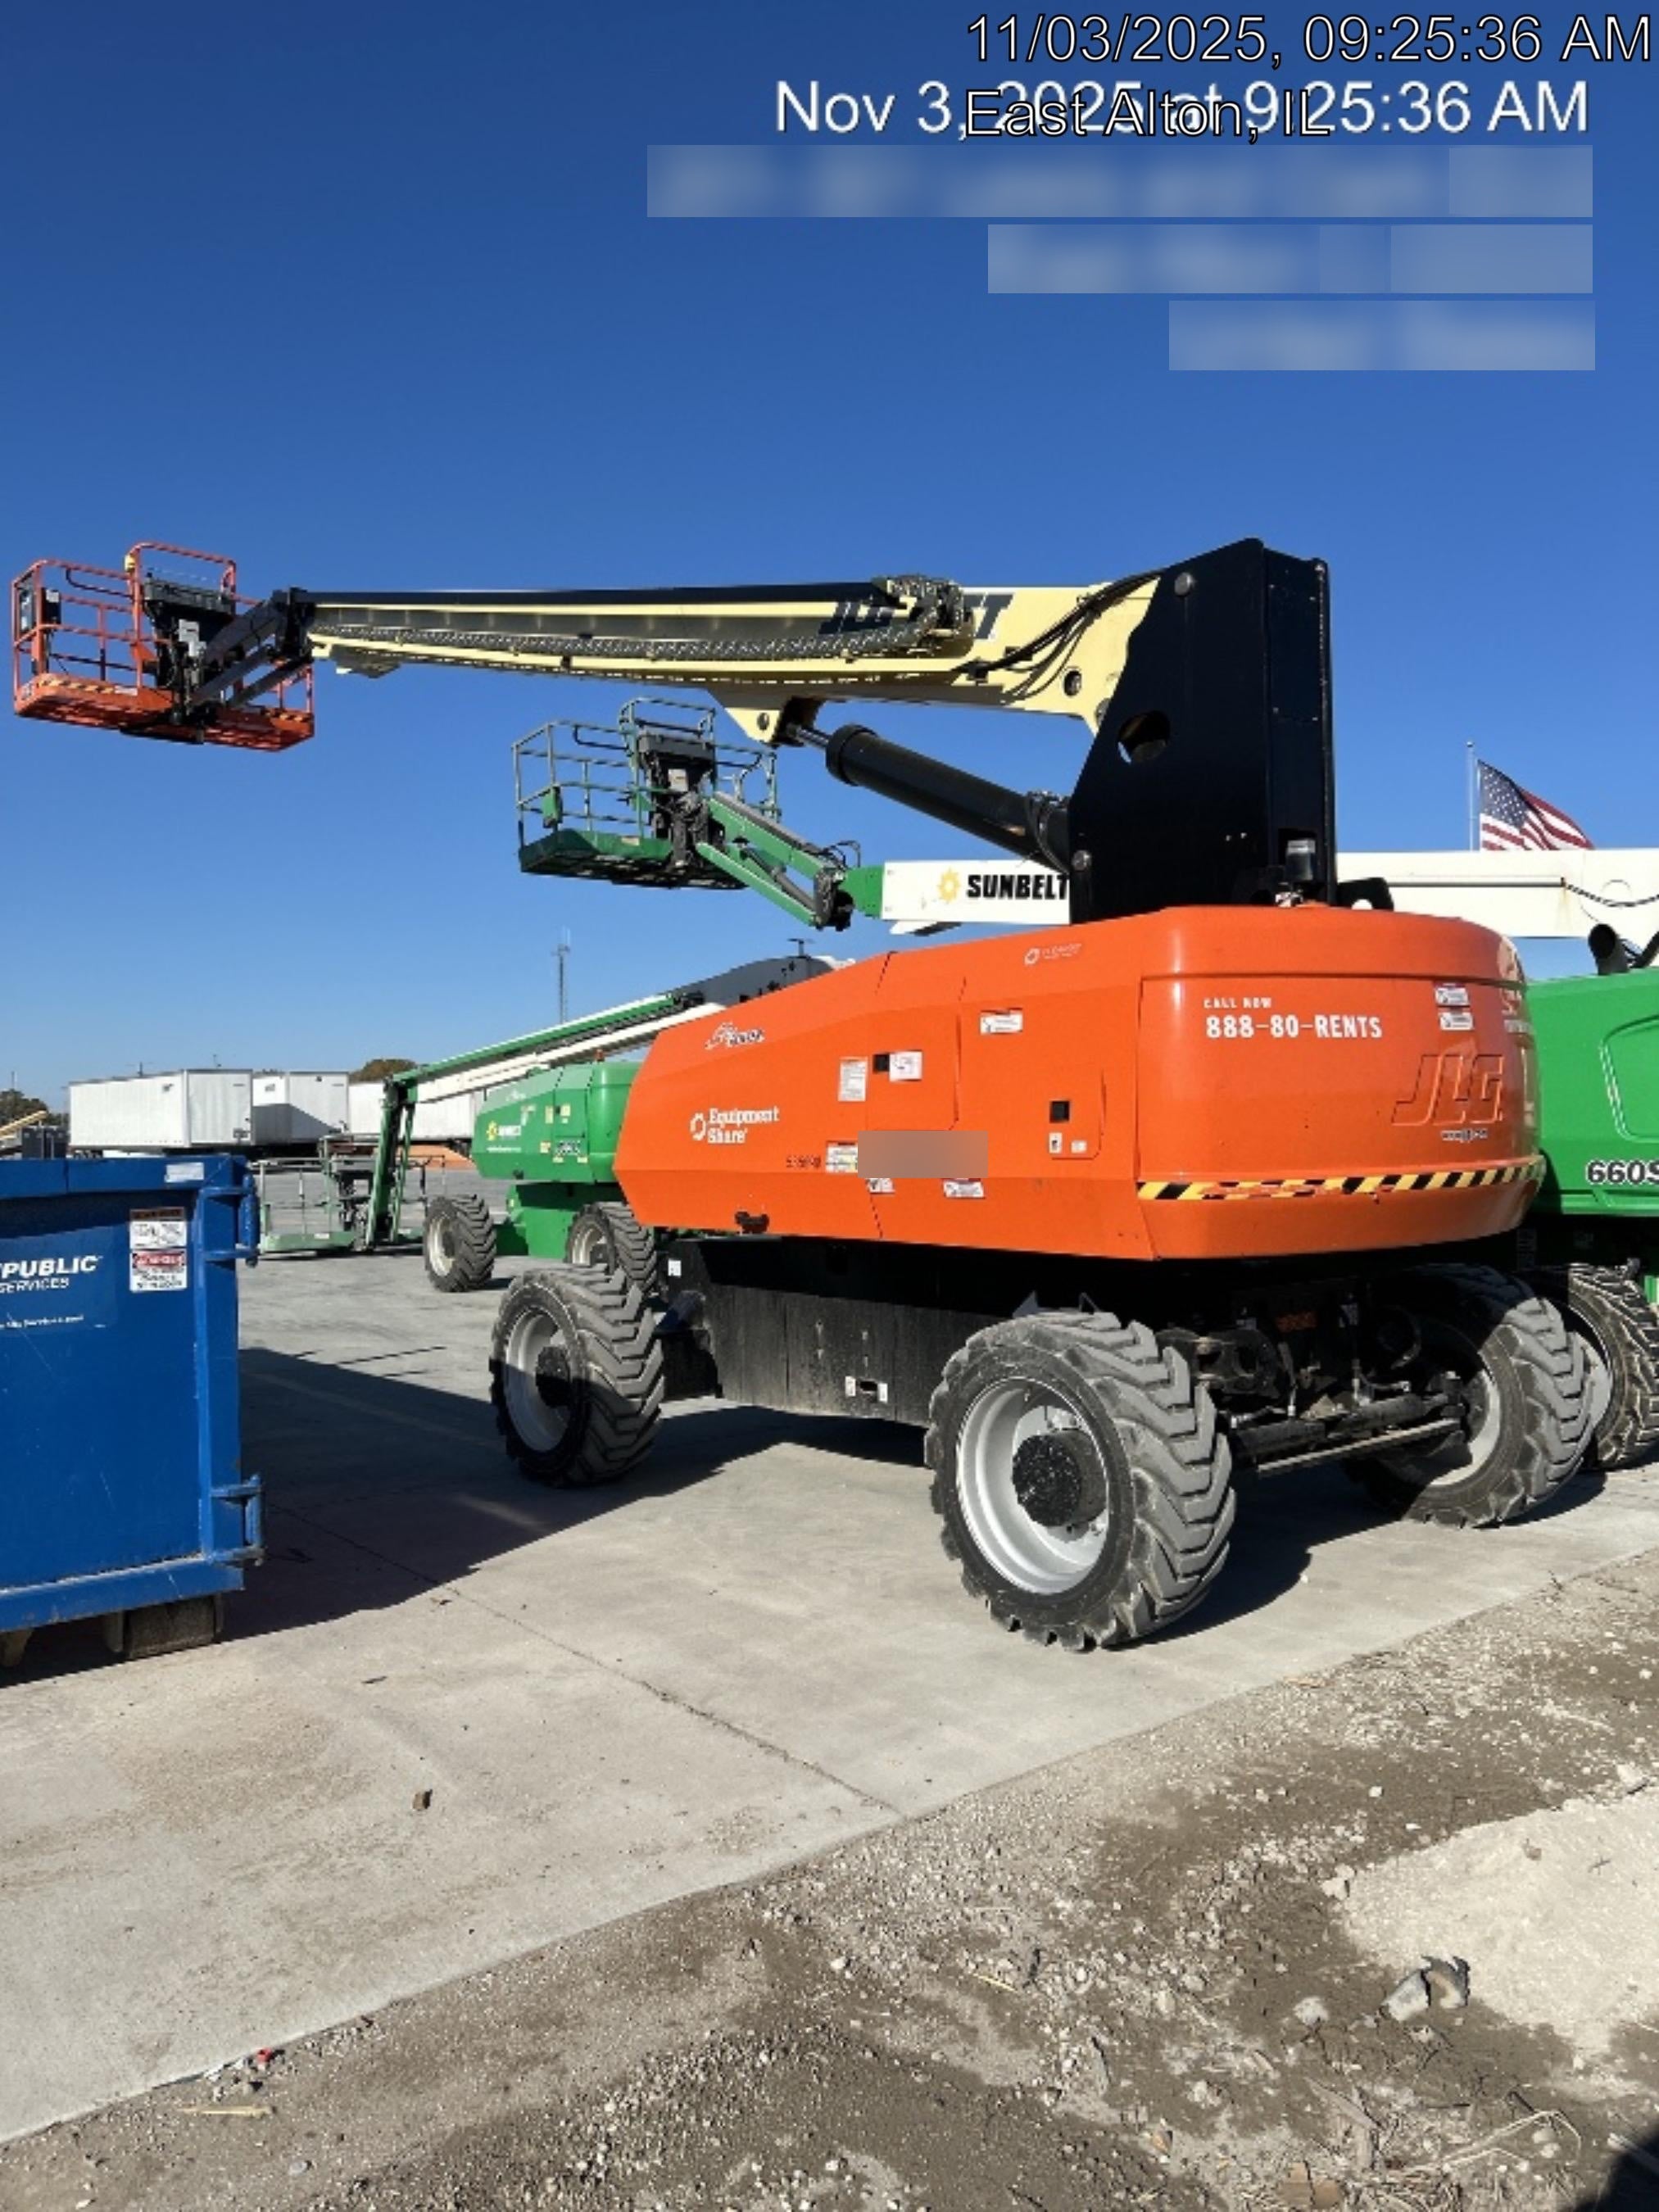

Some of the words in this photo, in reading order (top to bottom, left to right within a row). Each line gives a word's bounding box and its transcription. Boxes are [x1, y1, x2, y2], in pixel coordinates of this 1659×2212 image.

[968, 874, 1068, 900] SUNBELT
[1203, 997, 1237, 1009] CALL
[1243, 997, 1272, 1009] NOW
[1206, 1014, 1383, 1038] 888-80-RENTS
[1392, 1054, 1504, 1126] JLG
[709, 1106, 780, 1128] Equipment
[708, 1128, 747, 1144] Share
[0, 1255, 98, 1279] PUBLIC
